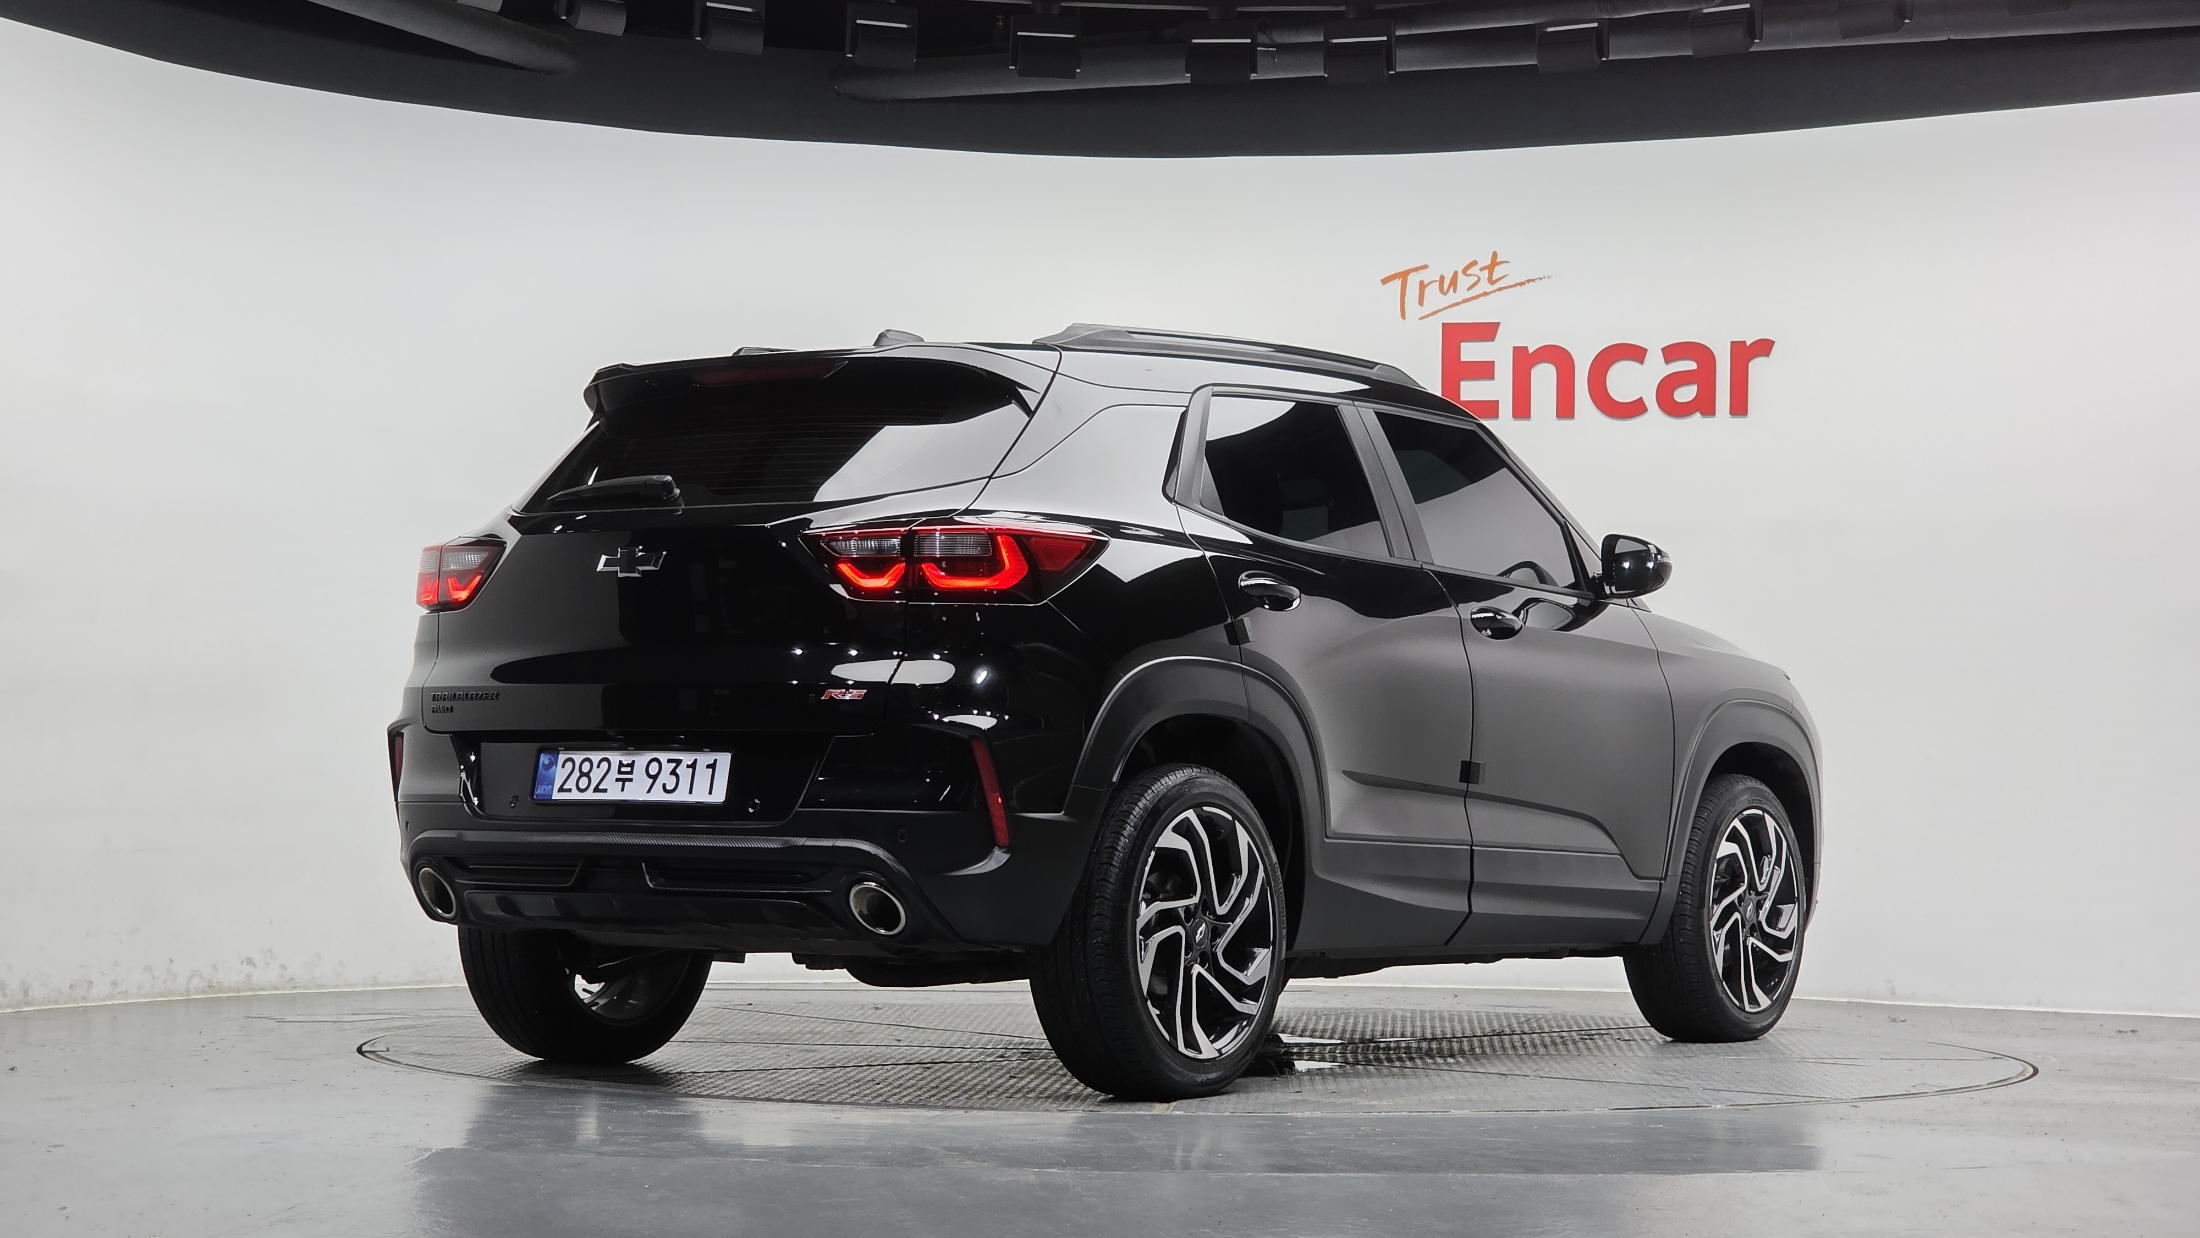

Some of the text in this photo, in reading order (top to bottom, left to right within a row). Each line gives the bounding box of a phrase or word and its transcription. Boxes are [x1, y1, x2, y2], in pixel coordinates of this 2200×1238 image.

[1381, 251, 1511, 321] Trust
[1441, 321, 1776, 420] Encar
[821, 688, 868, 700] RS
[557, 756, 718, 795] 282부 9311
